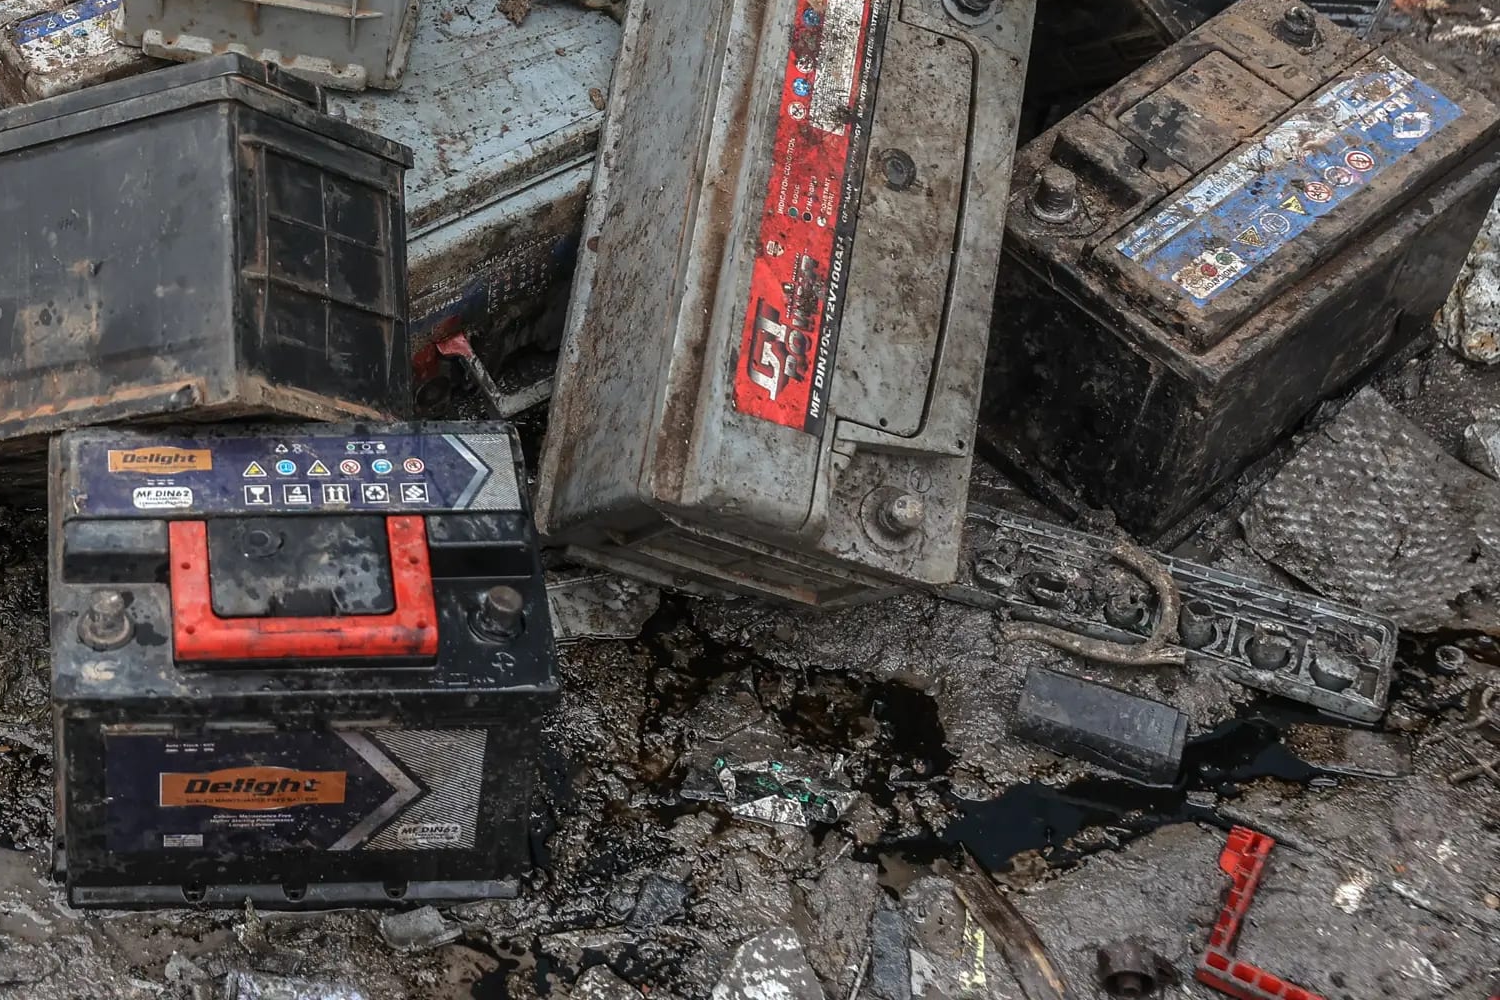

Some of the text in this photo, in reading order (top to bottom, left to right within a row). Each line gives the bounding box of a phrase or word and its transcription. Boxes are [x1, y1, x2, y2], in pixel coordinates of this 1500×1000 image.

[779, 177, 790, 216] INDICATOR
[1202, 265, 1236, 292] INDICATOR
[749, 300, 787, 401] GT
[810, 390, 821, 418] MF
[122, 453, 197, 466] Delight
[136, 490, 190, 498] MF DIN62
[185, 778, 321, 796] Delight
[401, 825, 459, 835] MF DIN62
